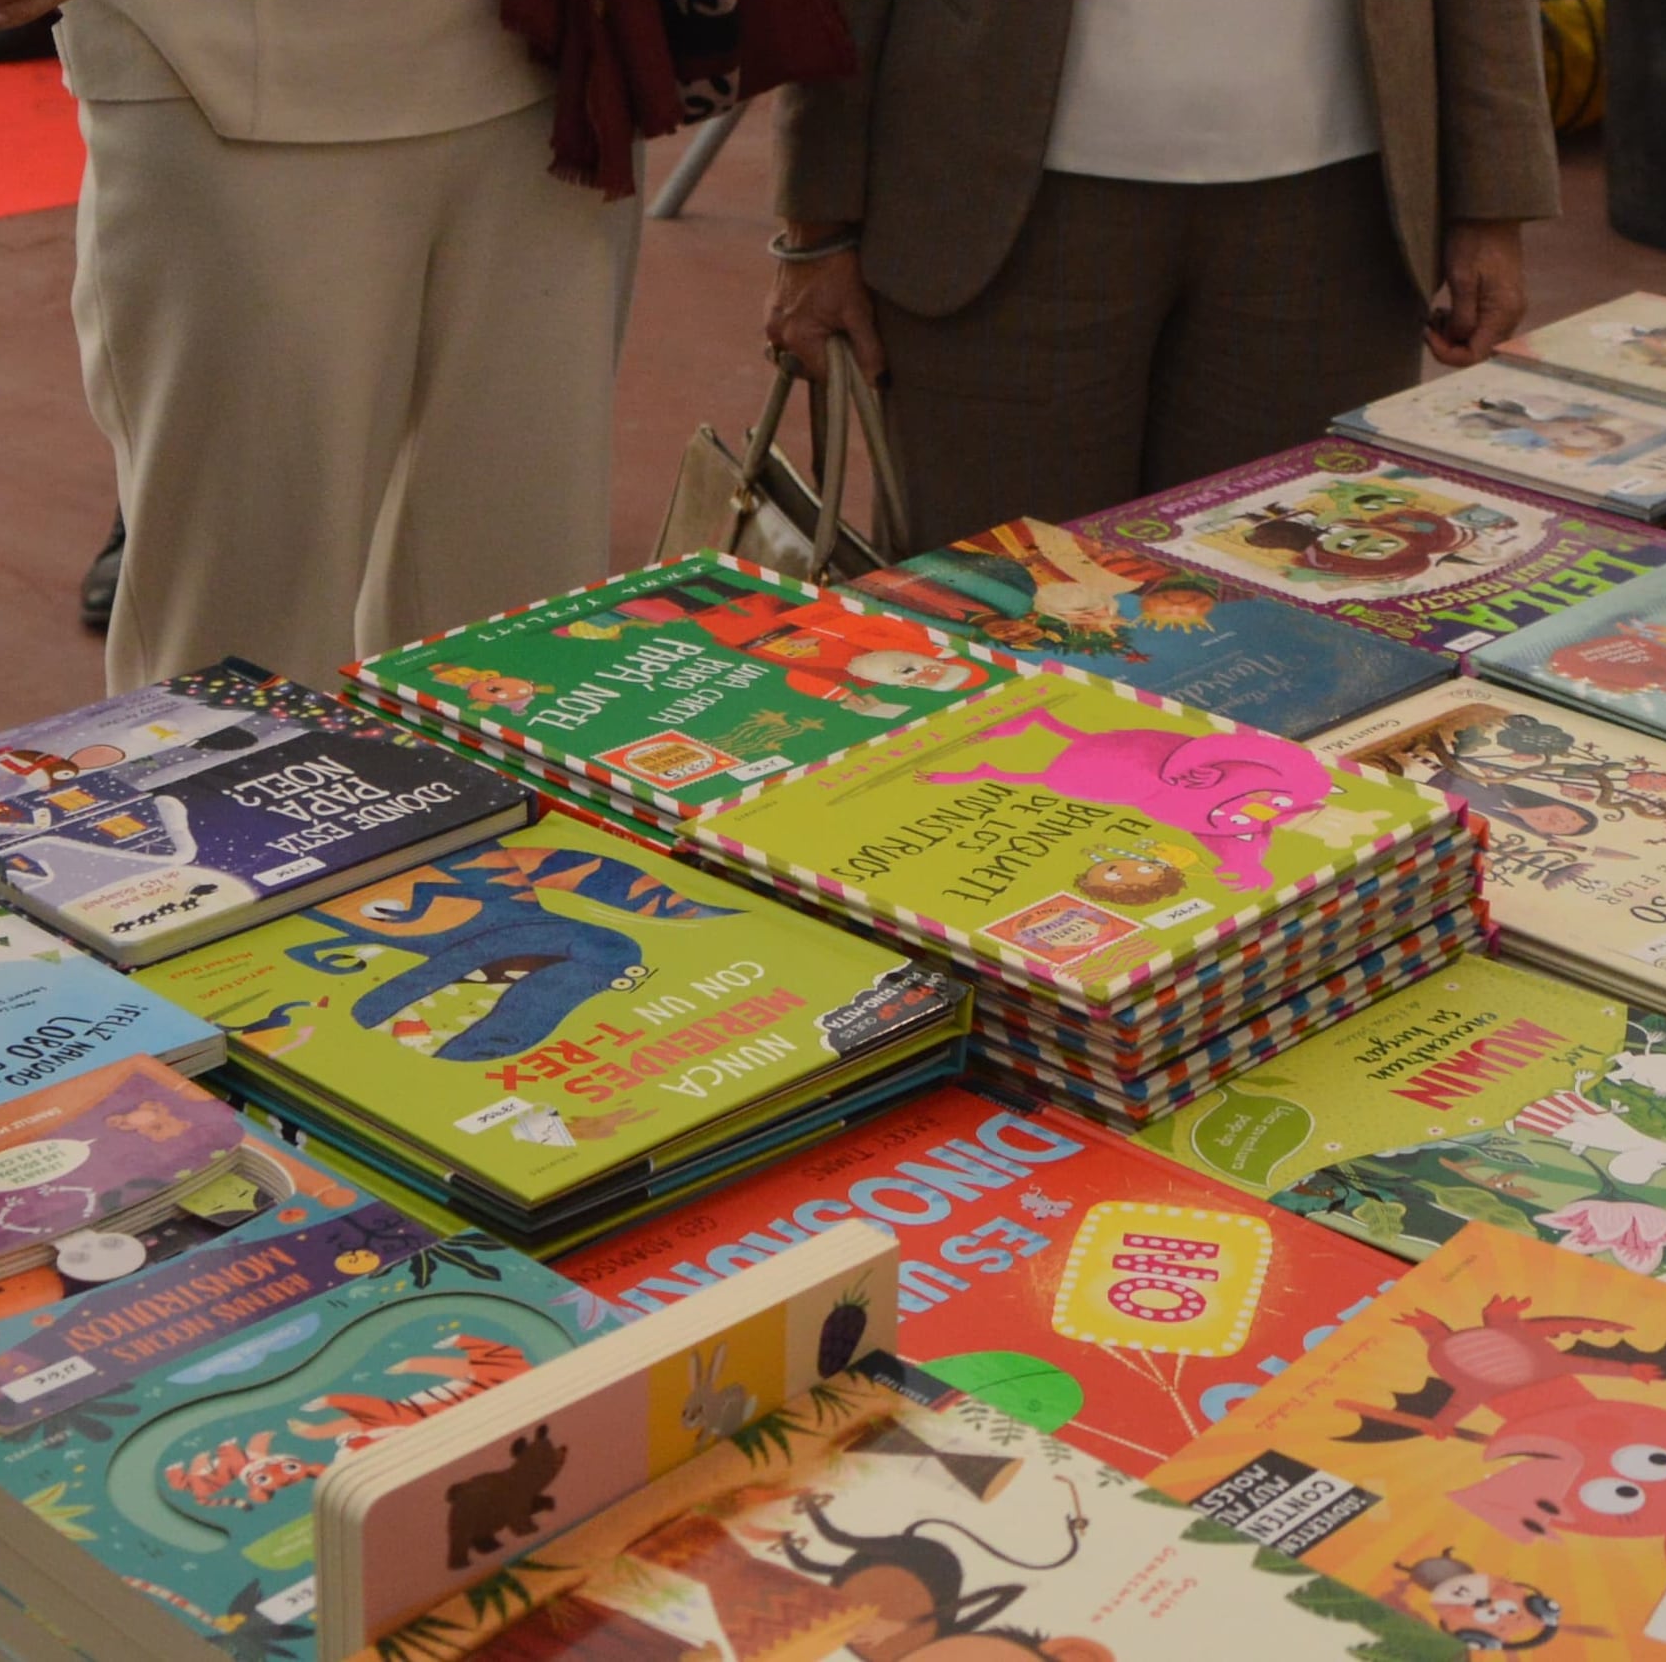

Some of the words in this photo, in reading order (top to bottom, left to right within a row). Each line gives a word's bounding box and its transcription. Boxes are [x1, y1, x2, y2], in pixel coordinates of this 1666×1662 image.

[617, 560, 709, 599] EMMA
[1448, 547, 1653, 635] LEILA
[475, 596, 602, 644] YARLETT
[609, 635, 705, 699] PAPÁ
[659, 654, 735, 693] PARA
[719, 658, 772, 697] UNA
[524, 677, 608, 733] NOEL
[645, 672, 724, 727] CARTA
[216, 753, 353, 810] NOEL?
[262, 774, 390, 824] PAPÁ
[346, 779, 454, 832] ¿DÓNDE
[828, 780, 1021, 884] MONSTRUOS
[1014, 792, 1061, 822] DE
[1102, 814, 1152, 842] EL
[262, 810, 349, 859] ESTÁ
[939, 797, 1115, 908] BANQUETE
[954, 813, 1014, 855] LOS
[1594, 860, 1658, 908] FLOR
[628, 983, 697, 1027] UN
[692, 958, 765, 1004] CON
[3, 1012, 80, 1065] LOBO
[85, 1000, 148, 1041] ¡FELIZ
[562, 984, 808, 1106] MERIENDES
[1350, 1020, 1428, 1069] hogar
[1421, 1005, 1463, 1036] su
[482, 1018, 649, 1092] T-REX
[657, 1032, 799, 1100] NUNCA
[1364, 1009, 1501, 1085] encuentran
[1386, 1017, 1571, 1113] MUMIN
[799, 1139, 878, 1183] TIMMS
[878, 1116, 939, 1158] BARRY
[674, 1215, 717, 1246] GED
[940, 1216, 1052, 1273] ES
[574, 1231, 674, 1283] ADAMSON
[1106, 1231, 1220, 1324] NO
[65, 1244, 297, 1353] MONSTRUITOS!
[1246, 1474, 1291, 1508] MUY
